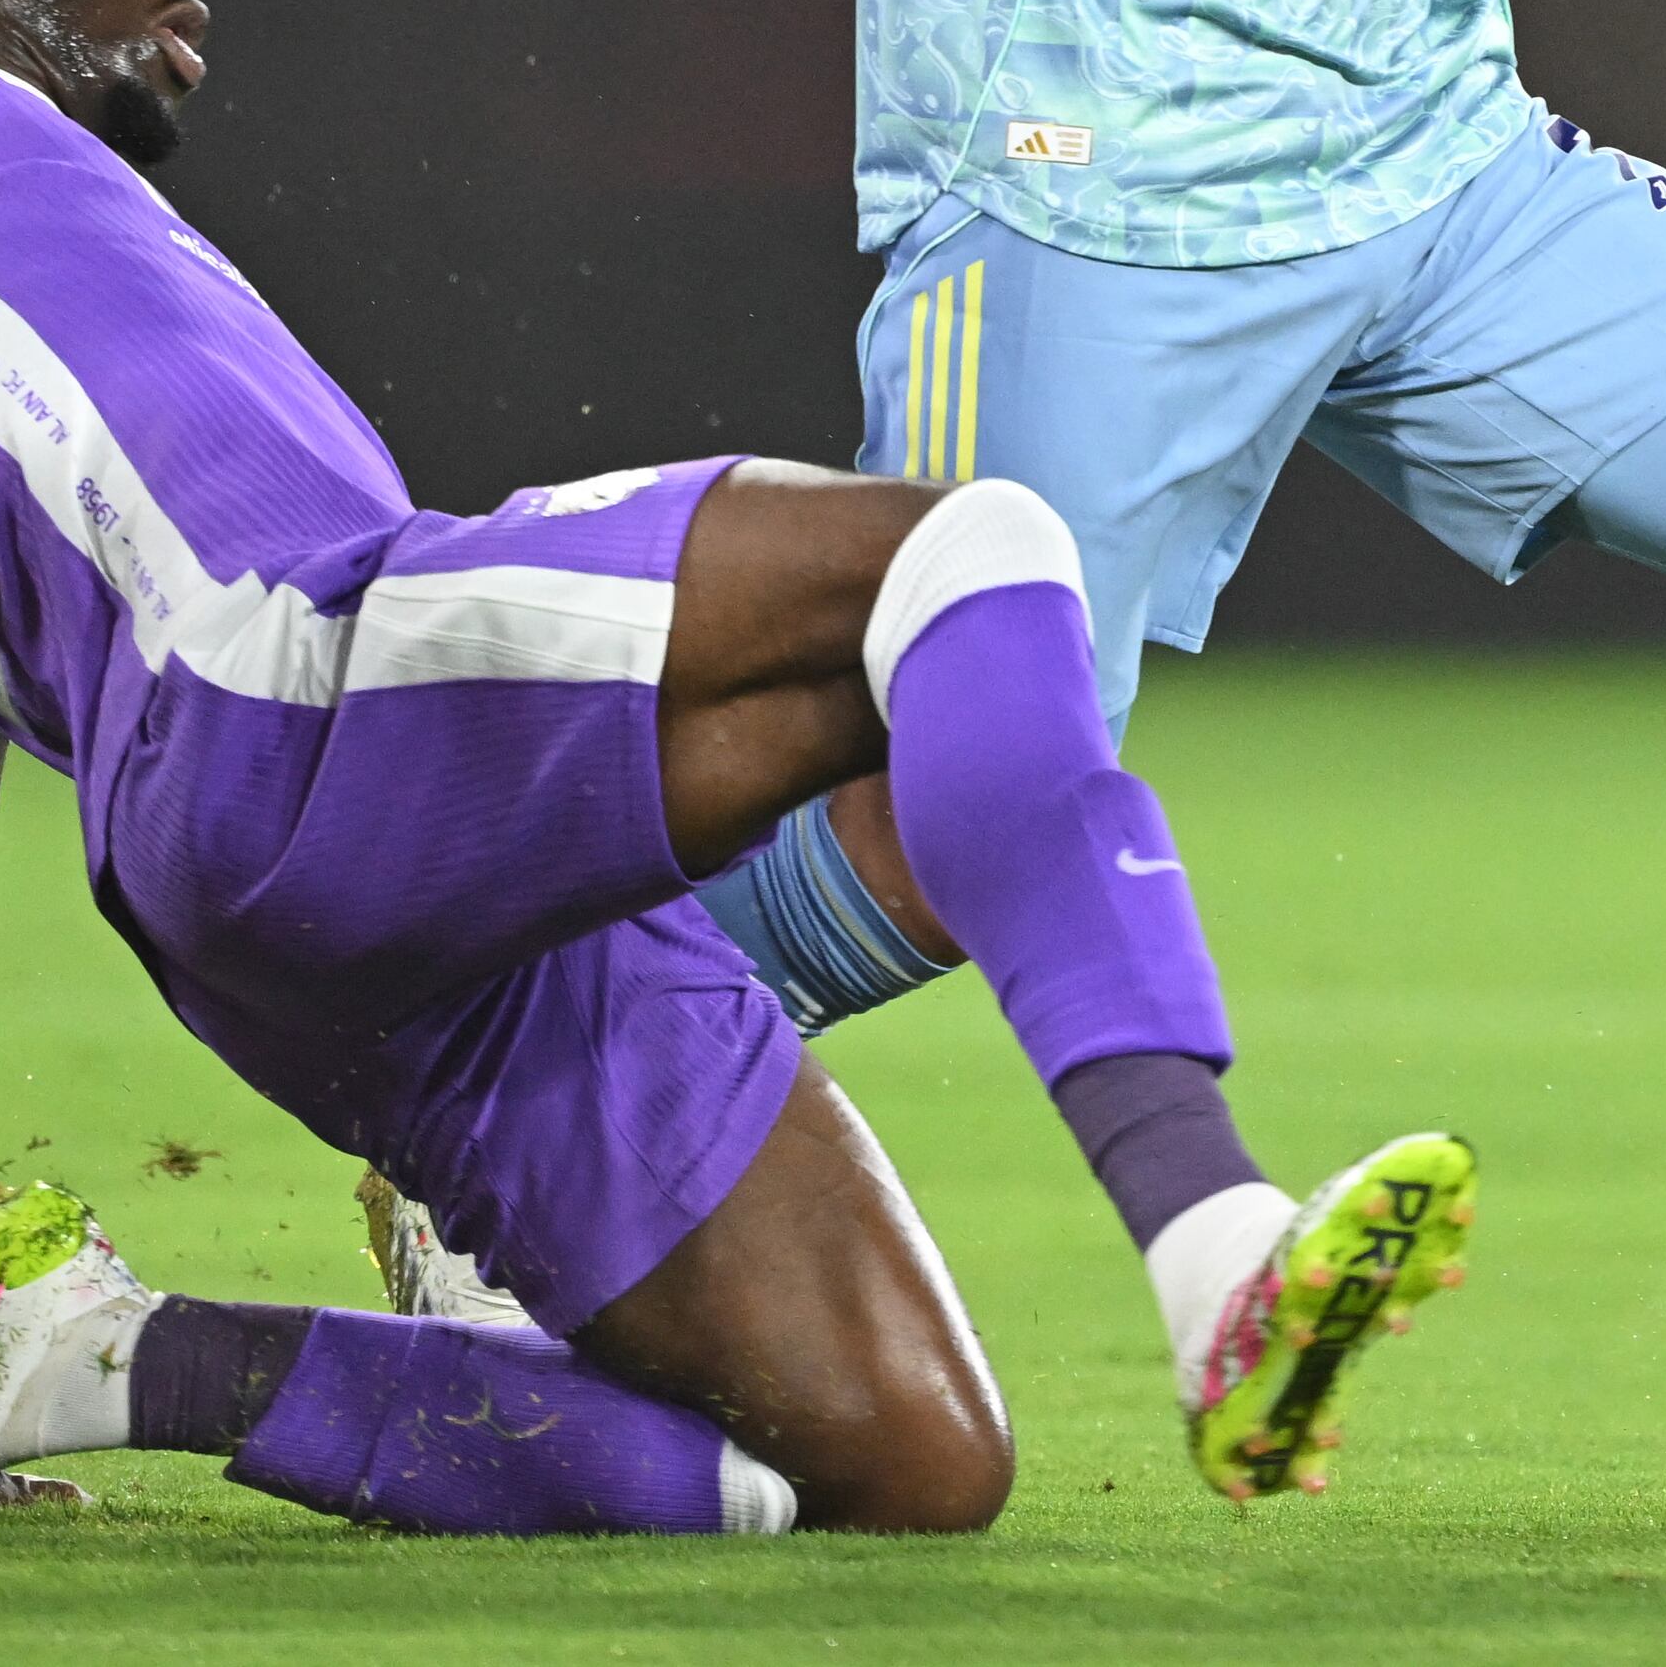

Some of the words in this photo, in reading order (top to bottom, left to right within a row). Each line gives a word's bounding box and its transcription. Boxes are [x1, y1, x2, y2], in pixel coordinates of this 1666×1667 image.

[0, 369, 26, 395] FC
[18, 389, 54, 422] AIN
[48, 417, 71, 445] AL
